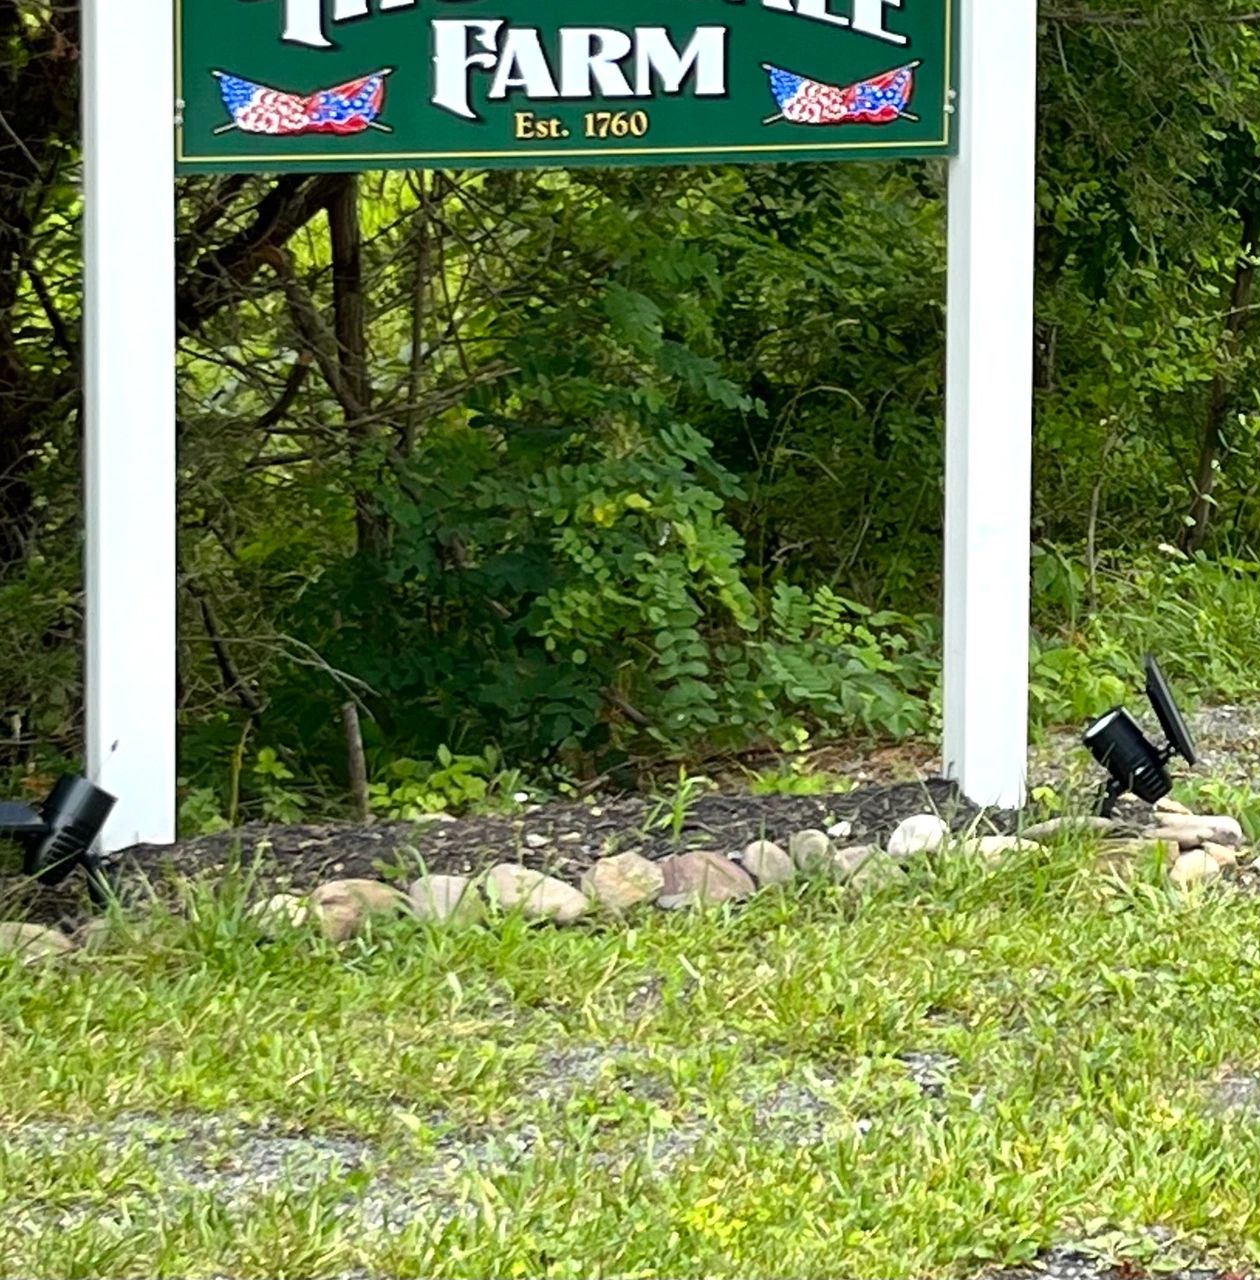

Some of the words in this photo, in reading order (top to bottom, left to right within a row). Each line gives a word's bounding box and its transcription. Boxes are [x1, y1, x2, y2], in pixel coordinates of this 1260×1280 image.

[431, 19, 727, 119] FARM
[514, 112, 570, 138] Est.
[584, 110, 648, 138] 1760
